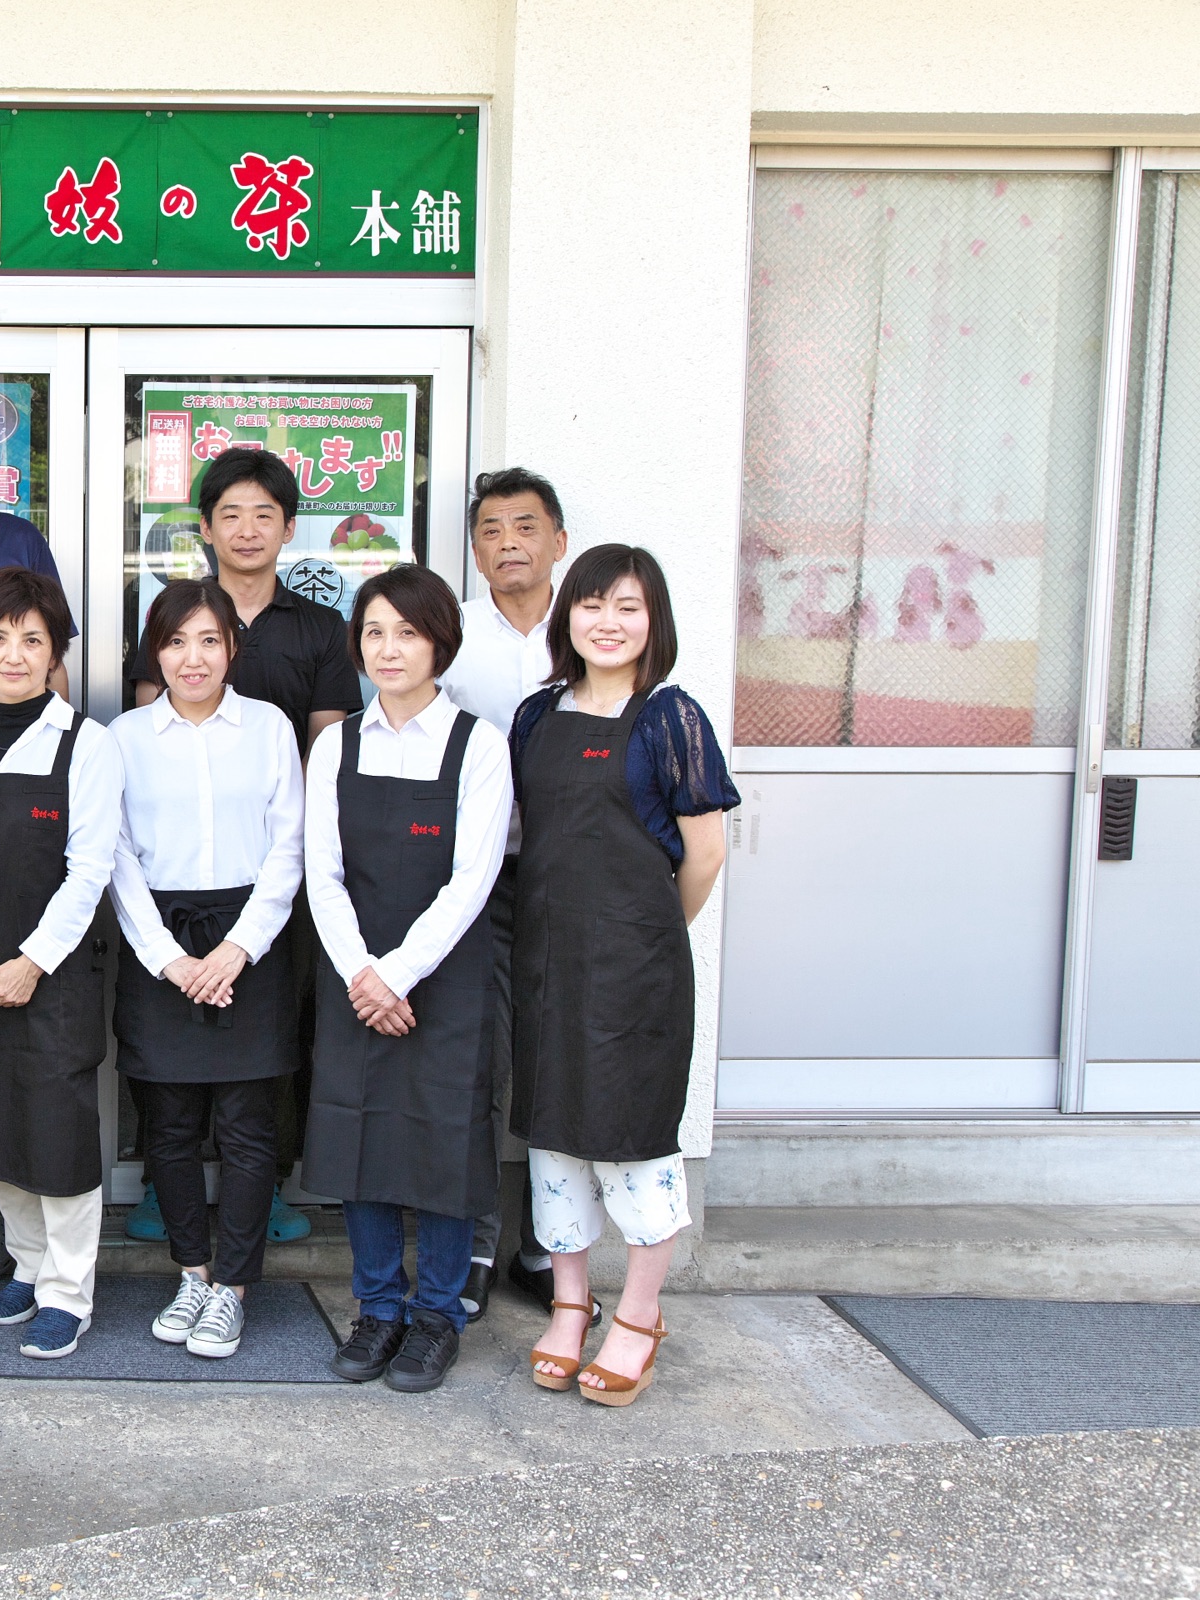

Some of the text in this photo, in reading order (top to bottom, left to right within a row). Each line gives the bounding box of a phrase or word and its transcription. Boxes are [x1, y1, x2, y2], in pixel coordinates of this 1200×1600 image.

[349, 189, 463, 258] 本舗
[152, 419, 185, 430] 配送料
[154, 432, 182, 493] 無料
[291, 566, 339, 602] 茶
